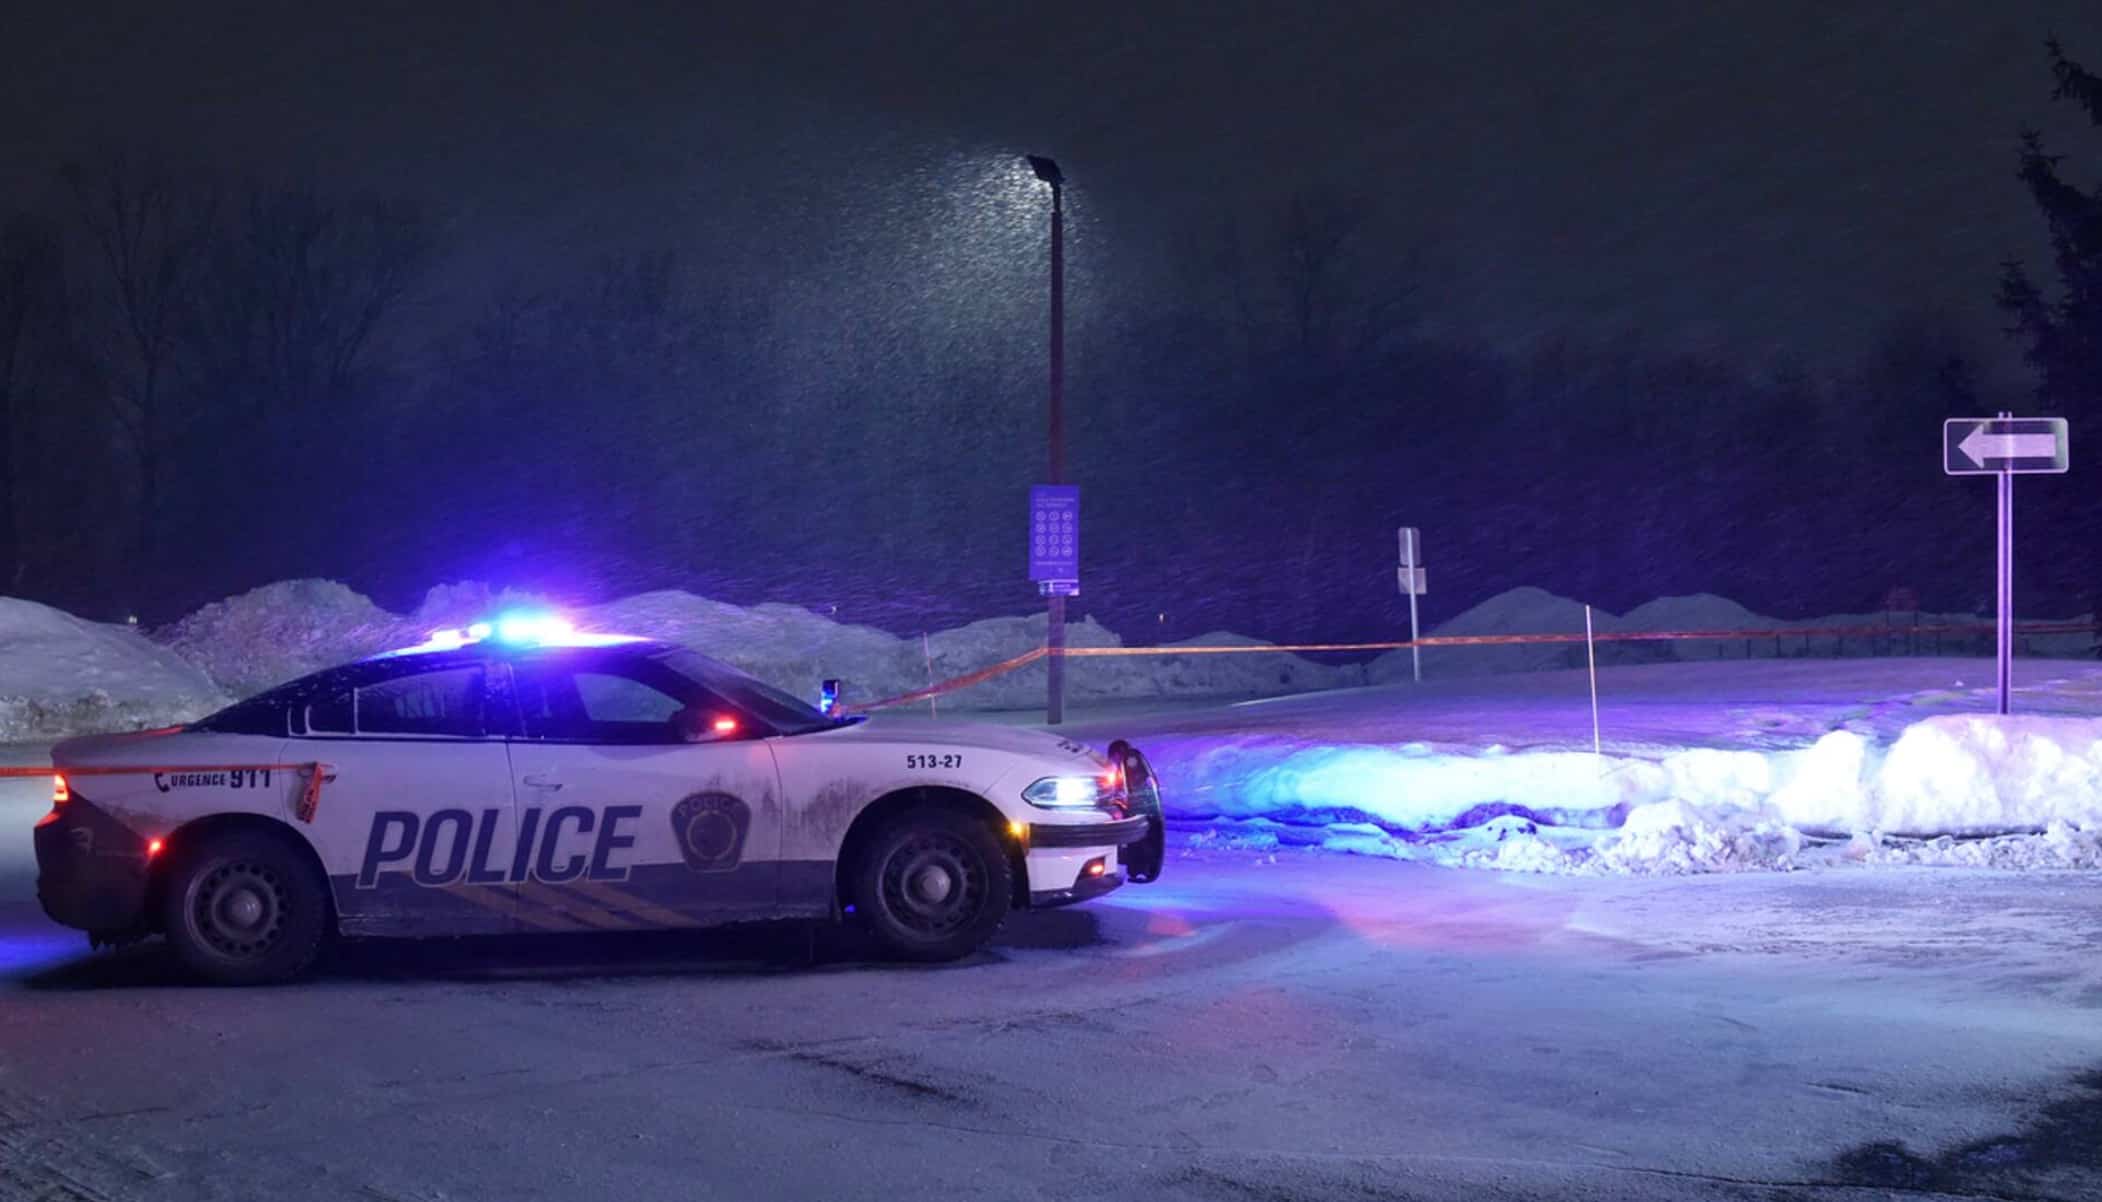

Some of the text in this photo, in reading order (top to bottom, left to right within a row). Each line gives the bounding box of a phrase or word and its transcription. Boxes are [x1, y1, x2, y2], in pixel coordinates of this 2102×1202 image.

[907, 754, 962, 769] 513-27
[171, 769, 271, 788] URGENCE 911
[356, 804, 643, 889] POLICE
